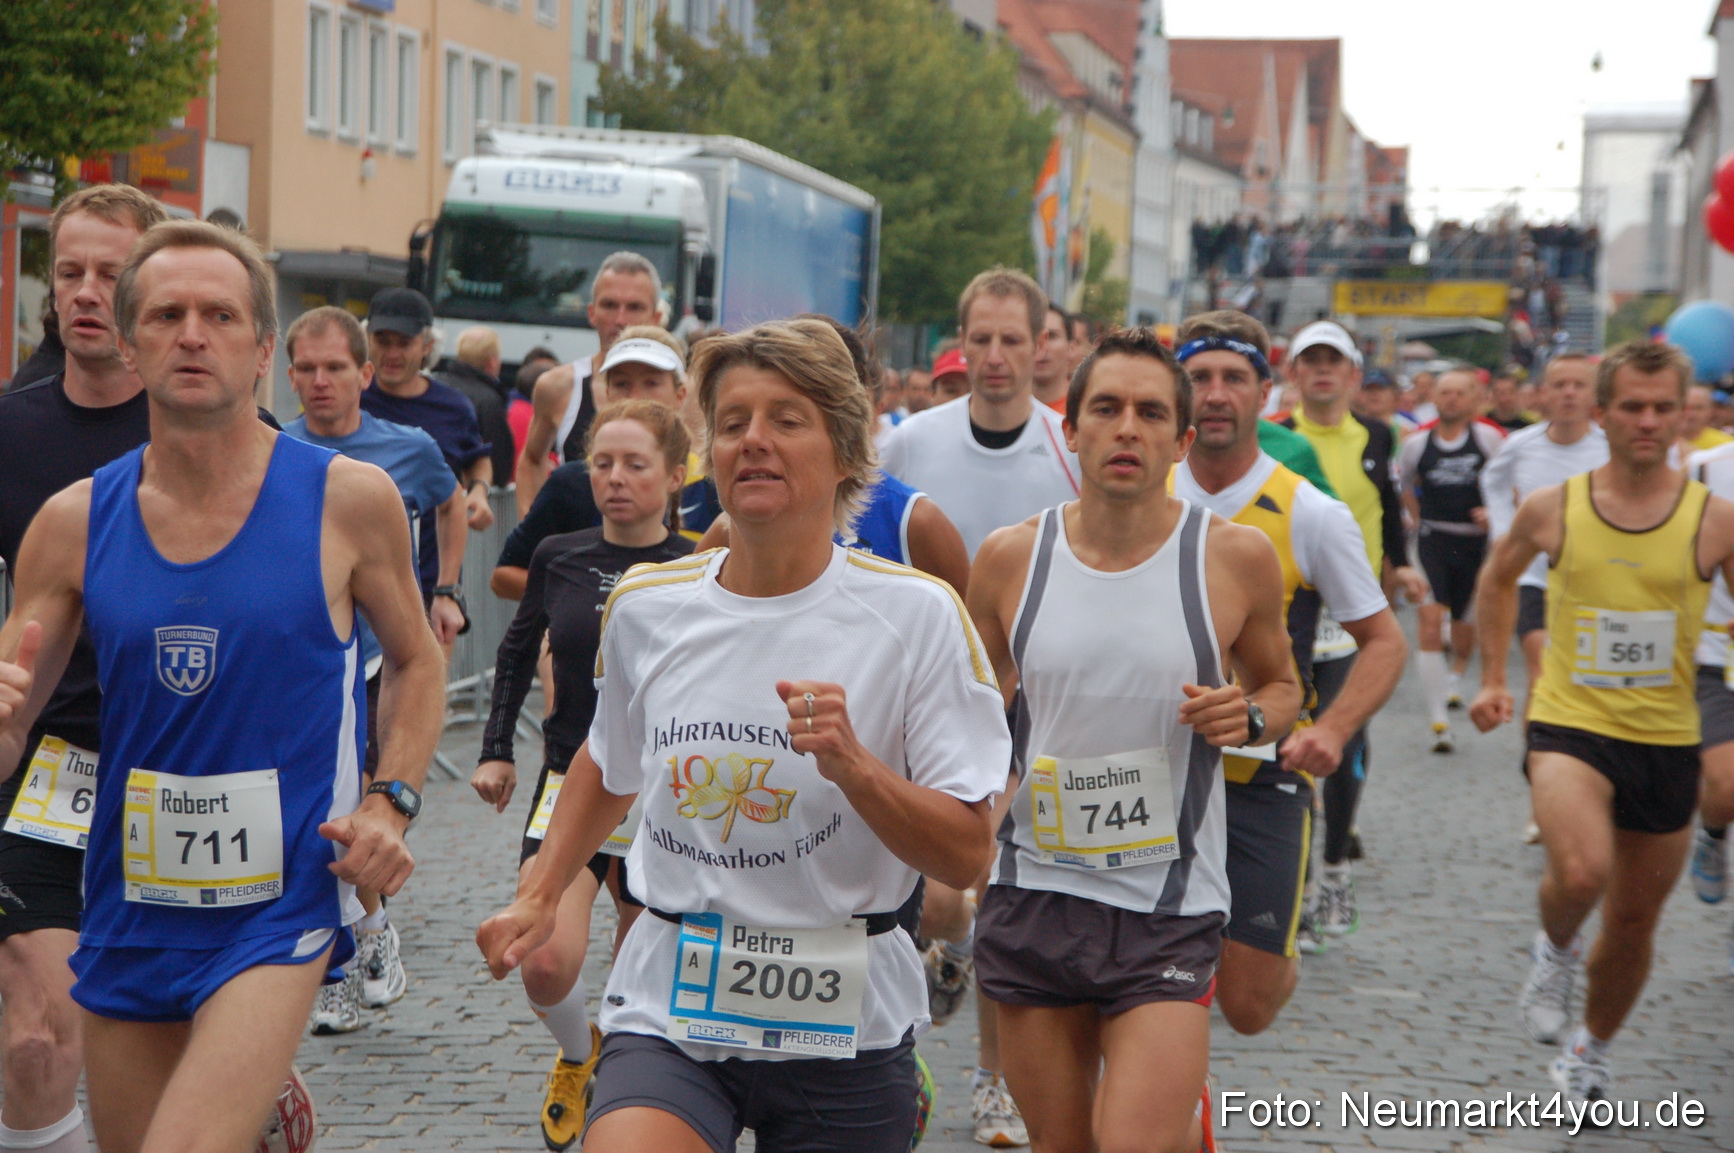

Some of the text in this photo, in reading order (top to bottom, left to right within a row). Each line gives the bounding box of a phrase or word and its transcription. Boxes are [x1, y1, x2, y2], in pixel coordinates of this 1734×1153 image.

[160, 630, 213, 641] TURNERBUND
[1610, 642, 1655, 663] 561
[66, 751, 99, 777] Tho
[29, 774, 38, 789] A
[1064, 767, 1141, 790] Joachim
[71, 787, 96, 814] 6
[162, 788, 229, 814] Robert
[545, 796, 552, 807] A
[1038, 800, 1046, 815] A
[1080, 796, 1150, 834] 744
[129, 823, 138, 841] A
[175, 828, 248, 864] 711
[1123, 844, 1176, 860] PFLEIDERER
[141, 887, 177, 899] BOCK
[219, 880, 279, 898] PFLEIDERER
[732, 925, 794, 955] Petra
[688, 952, 699, 968] A
[729, 960, 841, 1003] 2003
[687, 1024, 735, 1038] BOCK
[783, 1031, 853, 1048] PFLEIDERER
